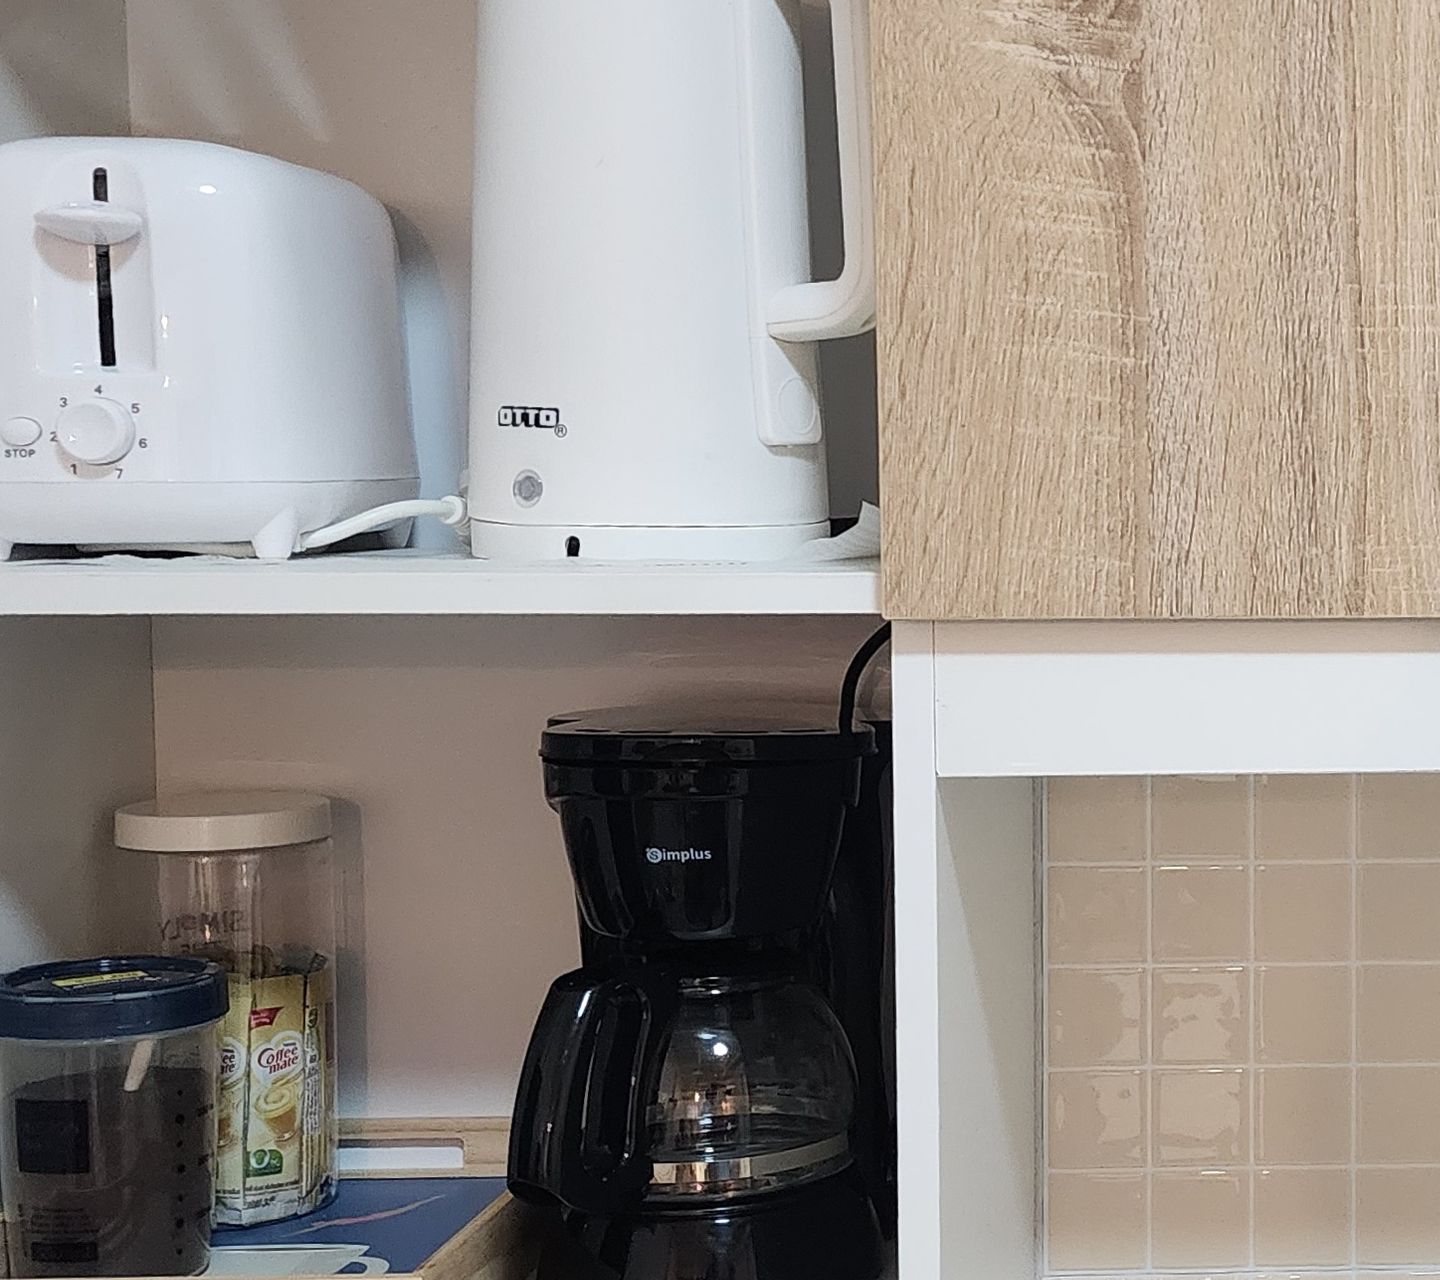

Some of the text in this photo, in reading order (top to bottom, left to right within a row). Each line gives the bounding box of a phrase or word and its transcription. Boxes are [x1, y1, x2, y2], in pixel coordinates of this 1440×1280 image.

[94, 385, 103, 394] 4
[60, 397, 68, 408] 3
[131, 403, 140, 414] 5
[498, 405, 560, 428] OTTO
[50, 431, 58, 442] 2
[139, 438, 148, 449] 6
[4, 449, 36, 458] STOP
[70, 464, 77, 475] 1
[114, 468, 123, 479] 7
[645, 847, 712, 864] Simplus
[257, 1046, 298, 1068] Coffee
[268, 1055, 299, 1075] mate
